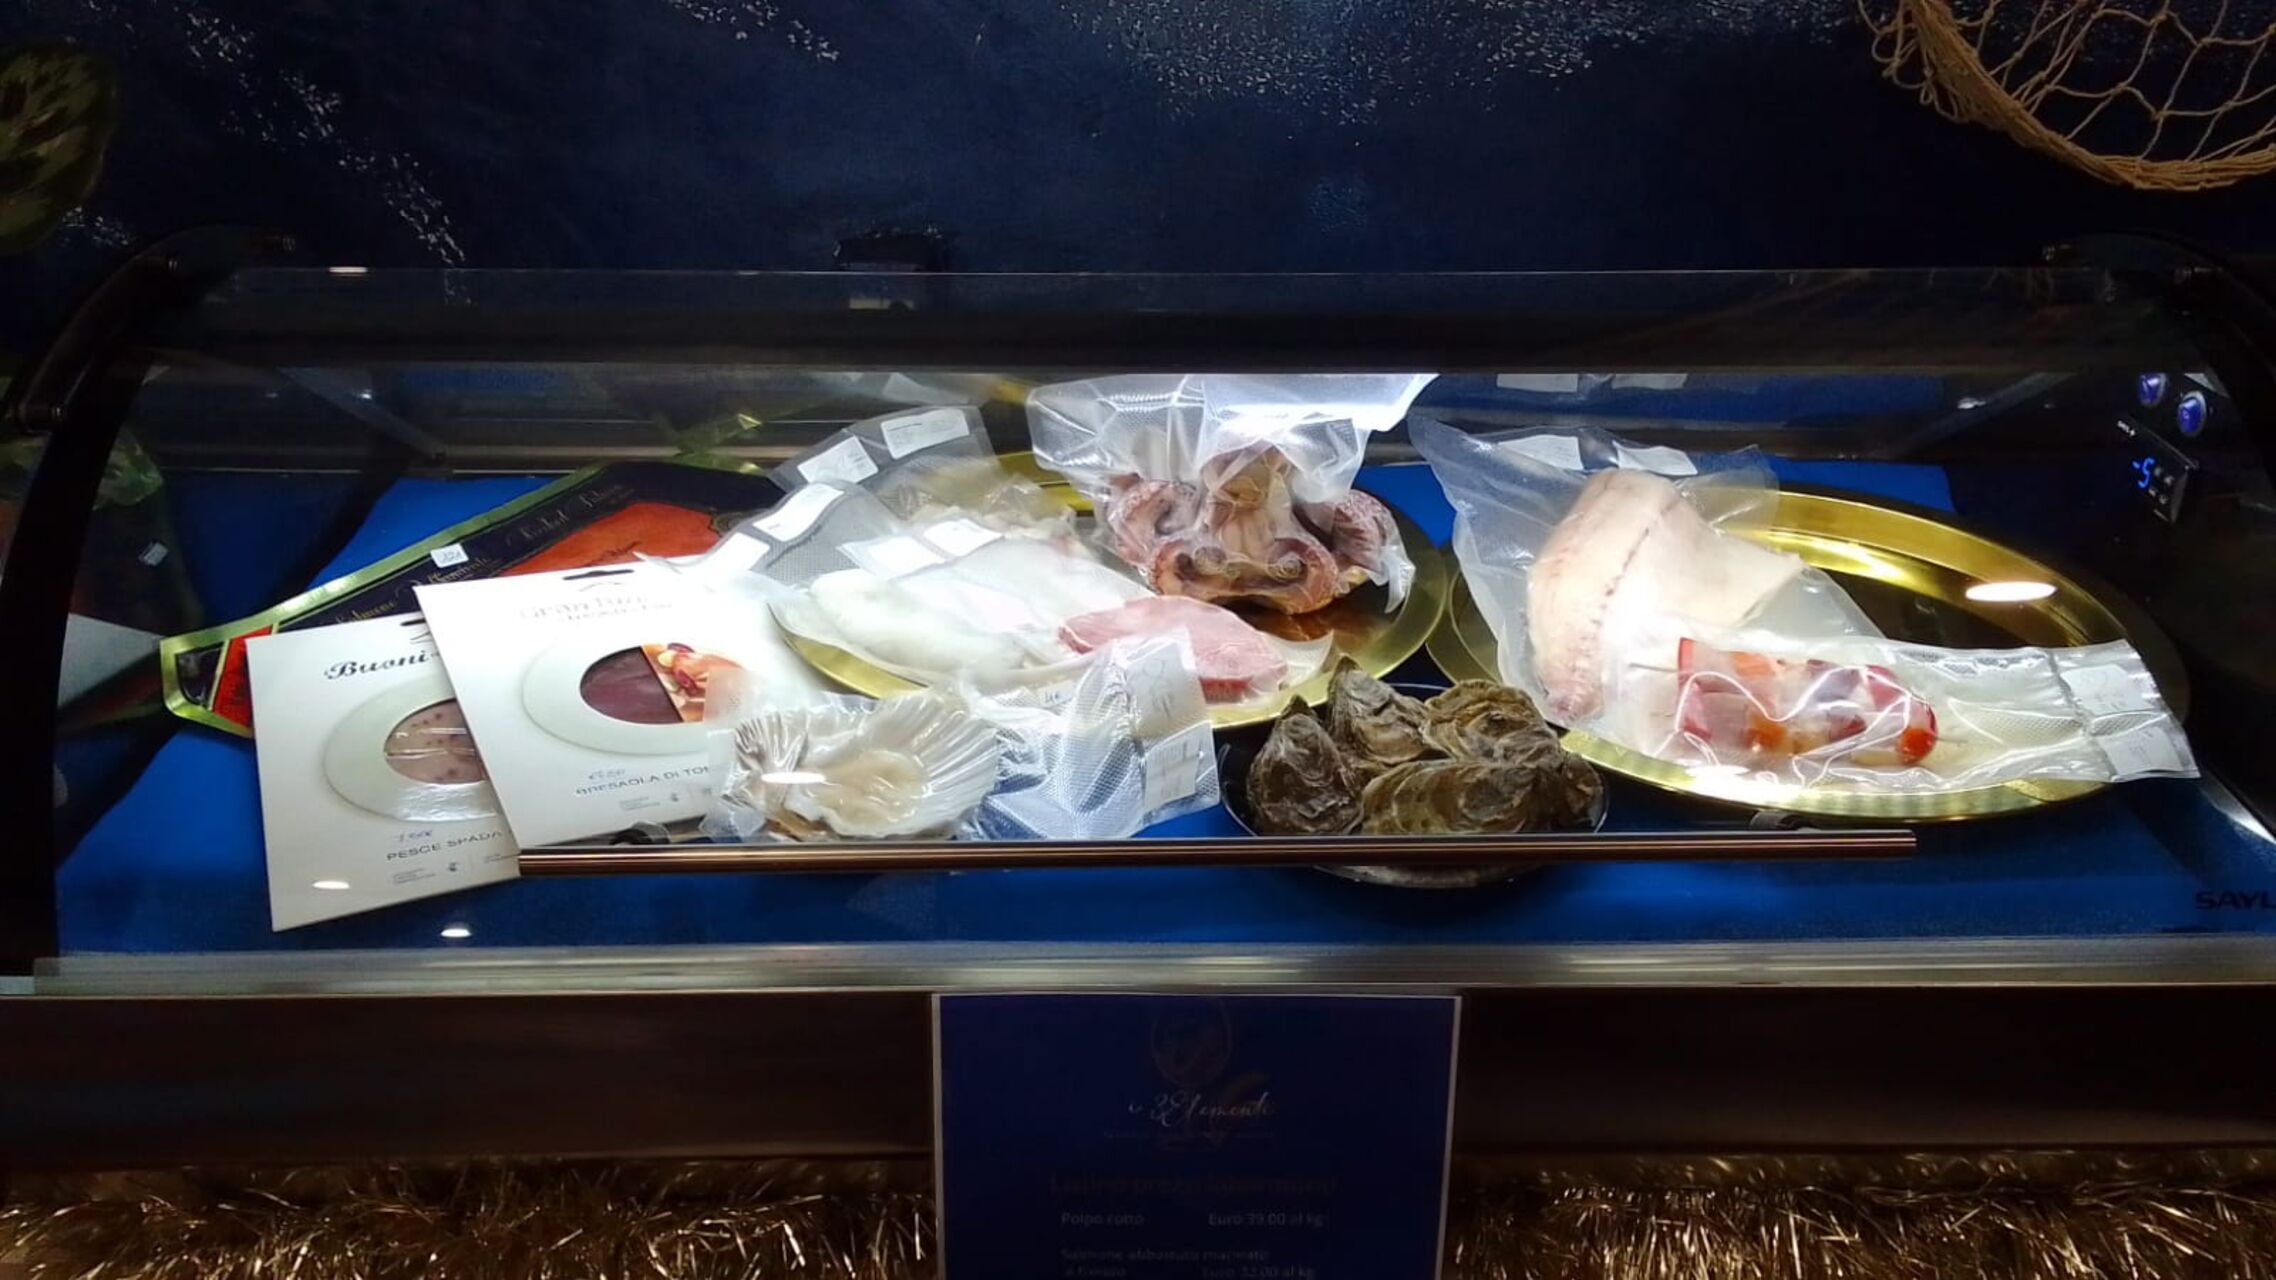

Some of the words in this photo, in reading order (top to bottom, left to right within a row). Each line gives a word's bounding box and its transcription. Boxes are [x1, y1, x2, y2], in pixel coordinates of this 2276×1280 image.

[386, 842, 442, 861] PESCE
[446, 830, 503, 848] SPADA
[1061, 1211, 1104, 1228] Polpo
[1208, 1212, 1244, 1226] Euro
